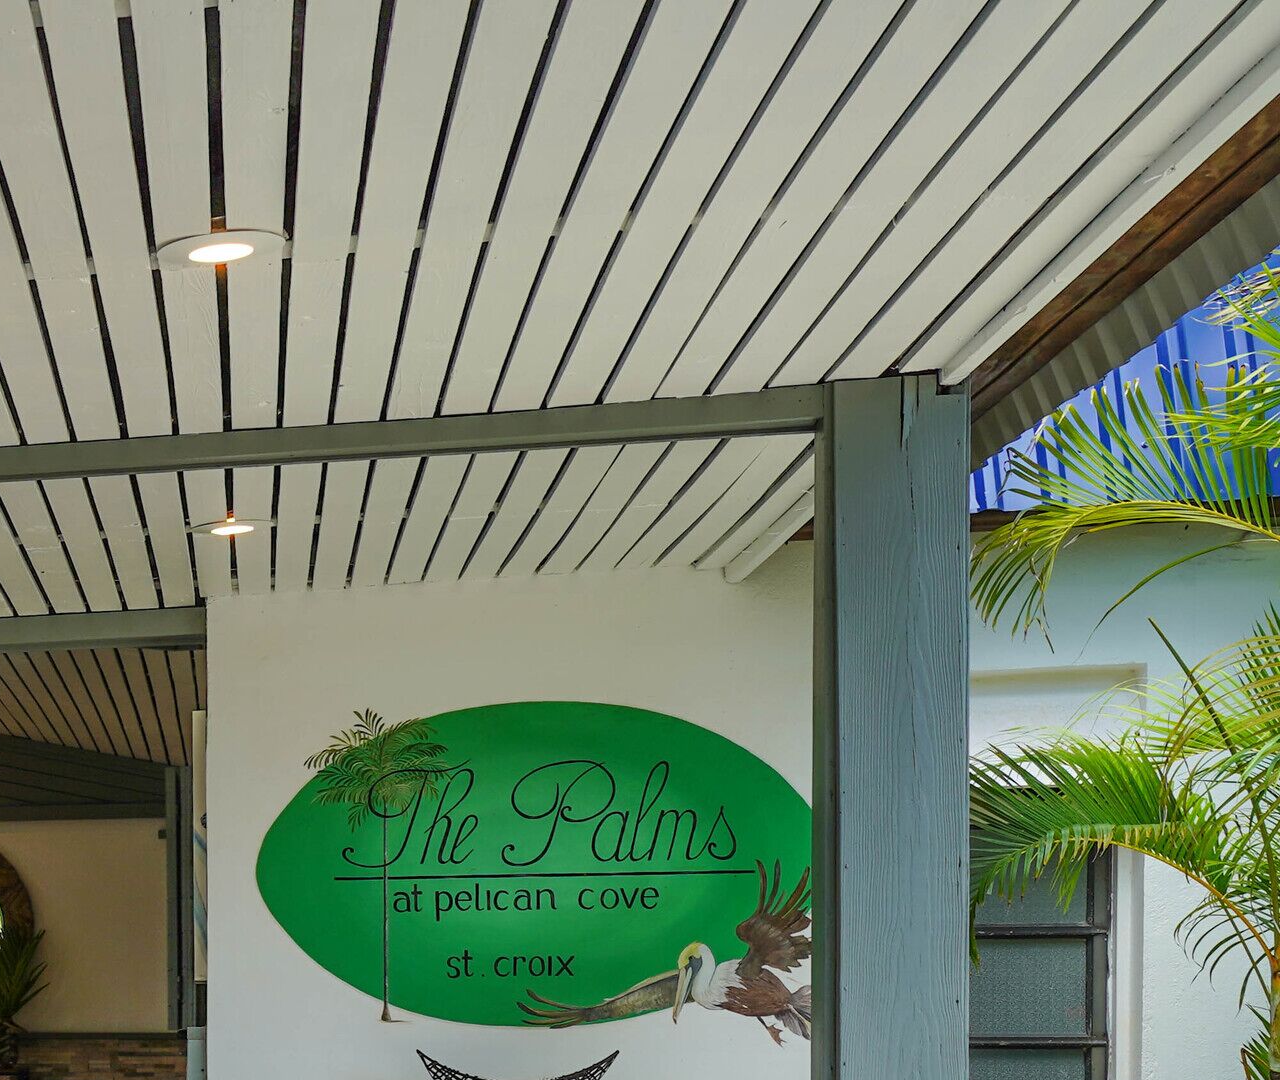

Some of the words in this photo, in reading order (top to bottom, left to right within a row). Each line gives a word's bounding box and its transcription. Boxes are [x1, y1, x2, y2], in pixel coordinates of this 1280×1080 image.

[342, 759, 478, 868] The
[501, 760, 737, 867] Palms
[393, 884, 422, 913] at
[435, 884, 557, 921] pelican
[578, 887, 659, 911] cove
[493, 953, 576, 978] croix
